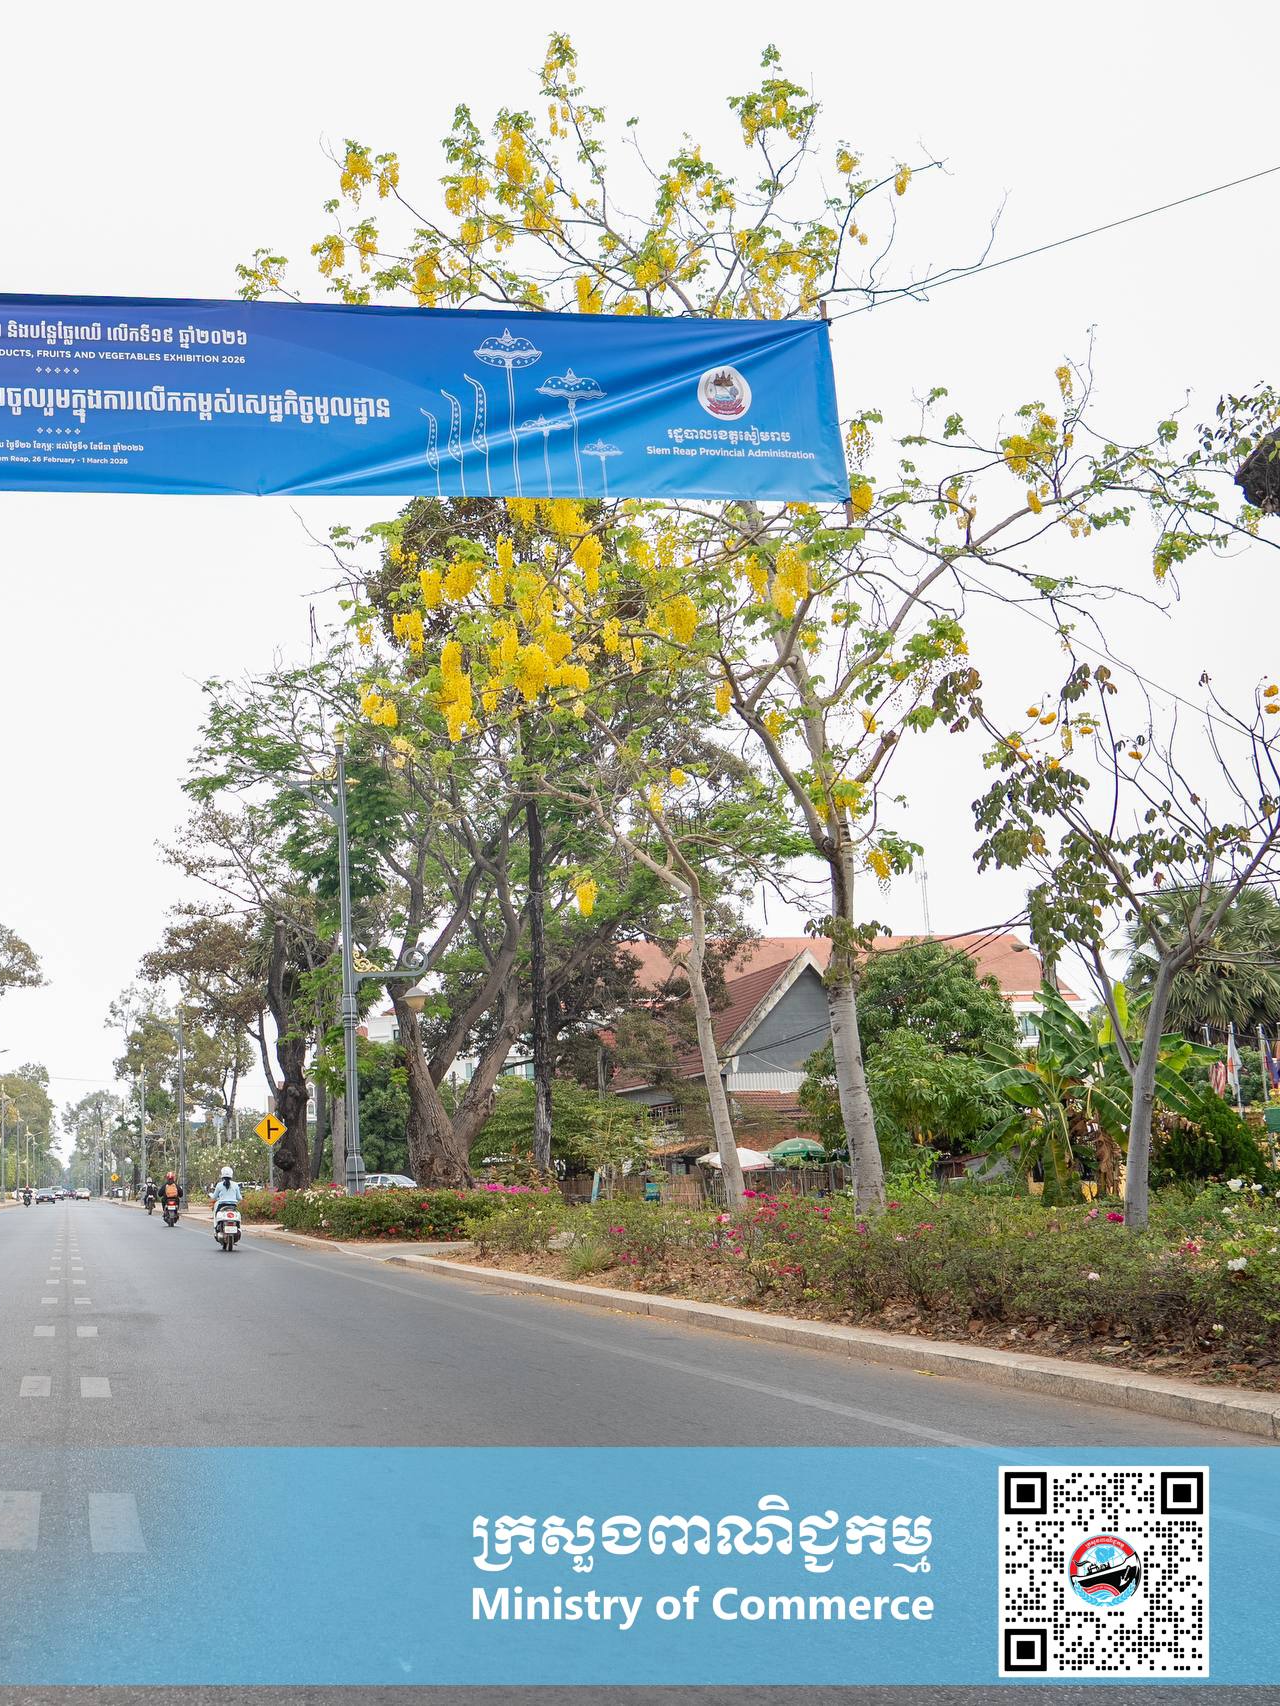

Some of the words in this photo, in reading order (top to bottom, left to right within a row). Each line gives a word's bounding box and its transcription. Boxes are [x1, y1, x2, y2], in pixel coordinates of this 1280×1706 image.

[7, 319, 102, 346] និងបន្លែផ្លែឈើ
[107, 323, 173, 343] លើកទី១៩
[178, 325, 247, 349] ឆ្នាំ២០២៦
[37, 349, 71, 359] FRUITS
[74, 351, 96, 359] AND
[99, 352, 161, 361] VEGETABLES
[163, 353, 219, 363] EXHIBITION
[221, 355, 246, 364] 2026
[10, 455, 31, 463] Reap,
[43, 456, 76, 464] February
[646, 446, 671, 455] Siem
[673, 447, 697, 457] Reap
[699, 447, 745, 458] Provincial
[747, 449, 815, 460] Administration
